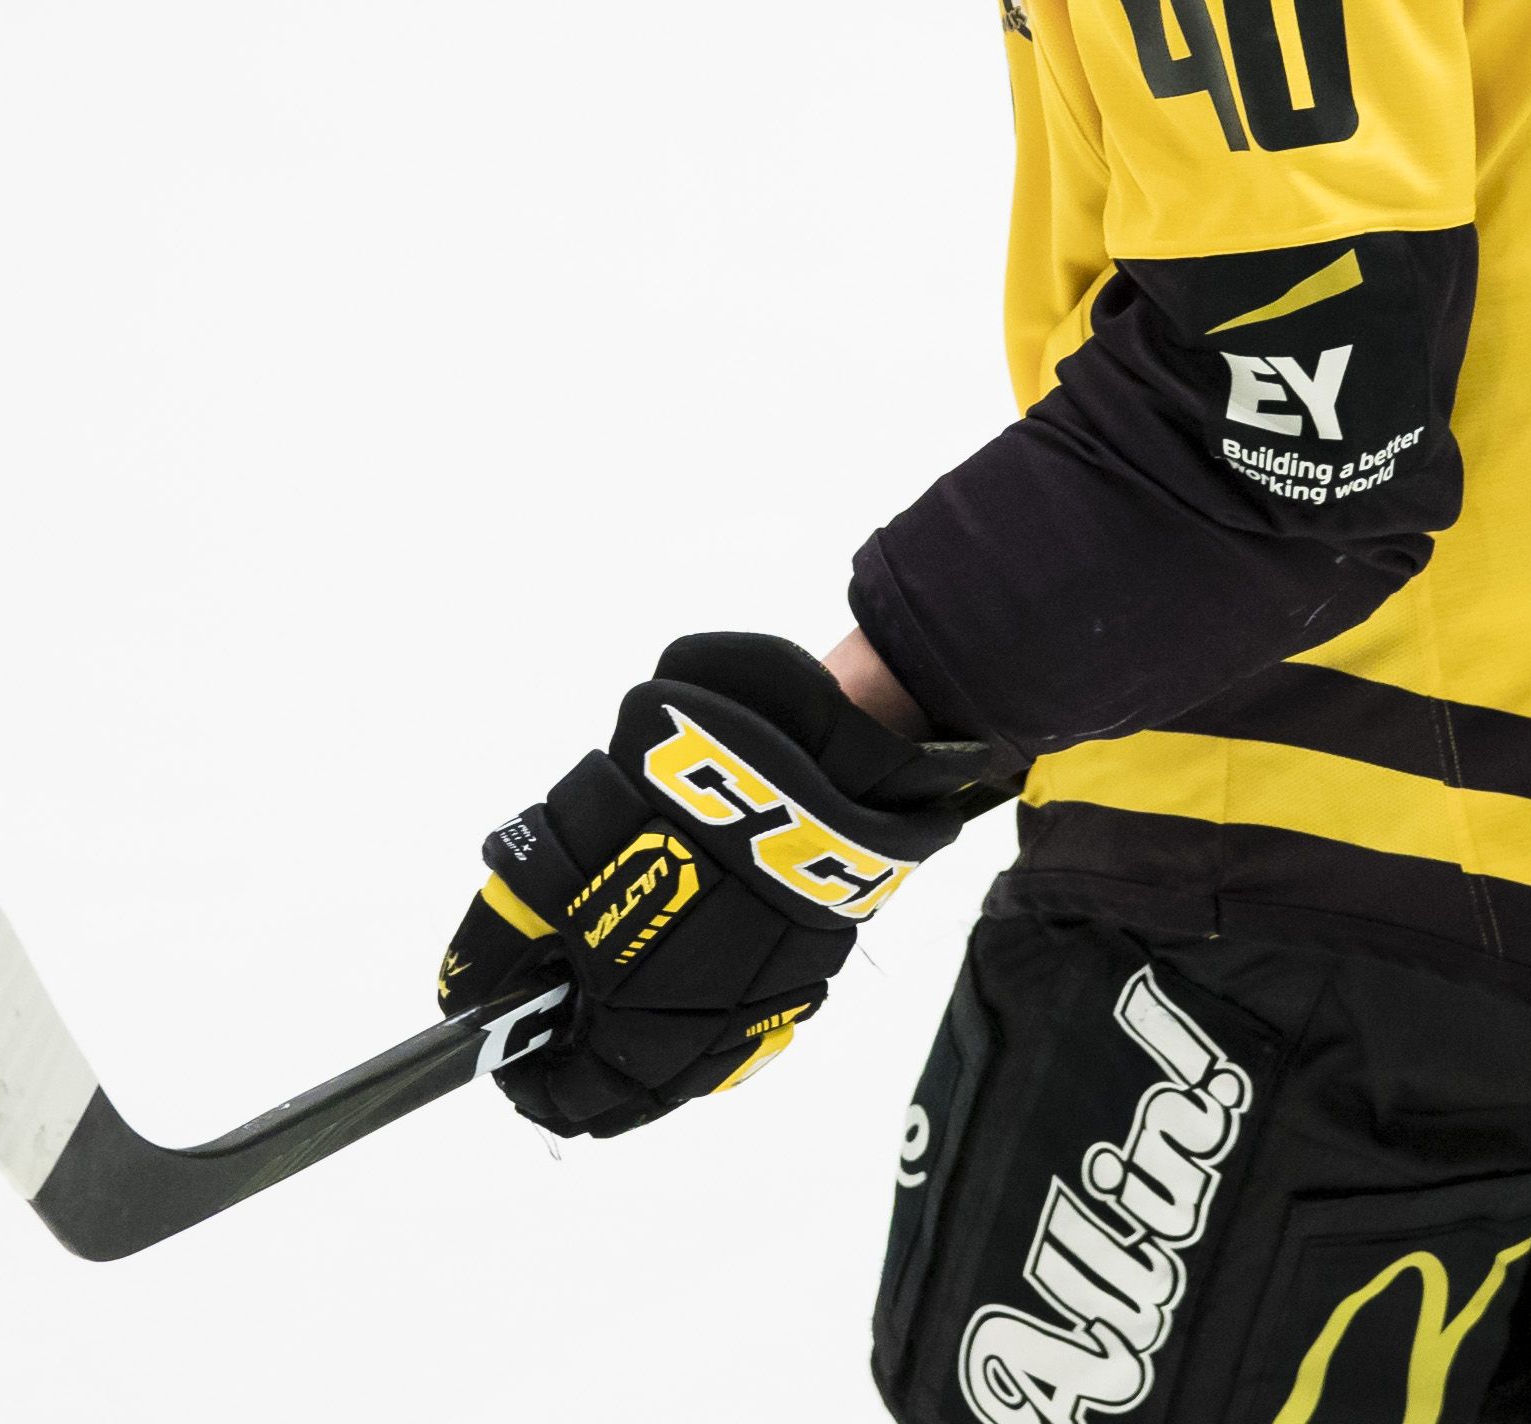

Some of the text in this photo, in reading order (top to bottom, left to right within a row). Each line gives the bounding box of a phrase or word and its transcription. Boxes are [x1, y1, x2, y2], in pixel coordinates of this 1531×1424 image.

[1219, 343, 1355, 441] EY
[1222, 426, 1425, 485] Building a better
[1334, 458, 1396, 500] world
[583, 856, 669, 949] ULTRA
